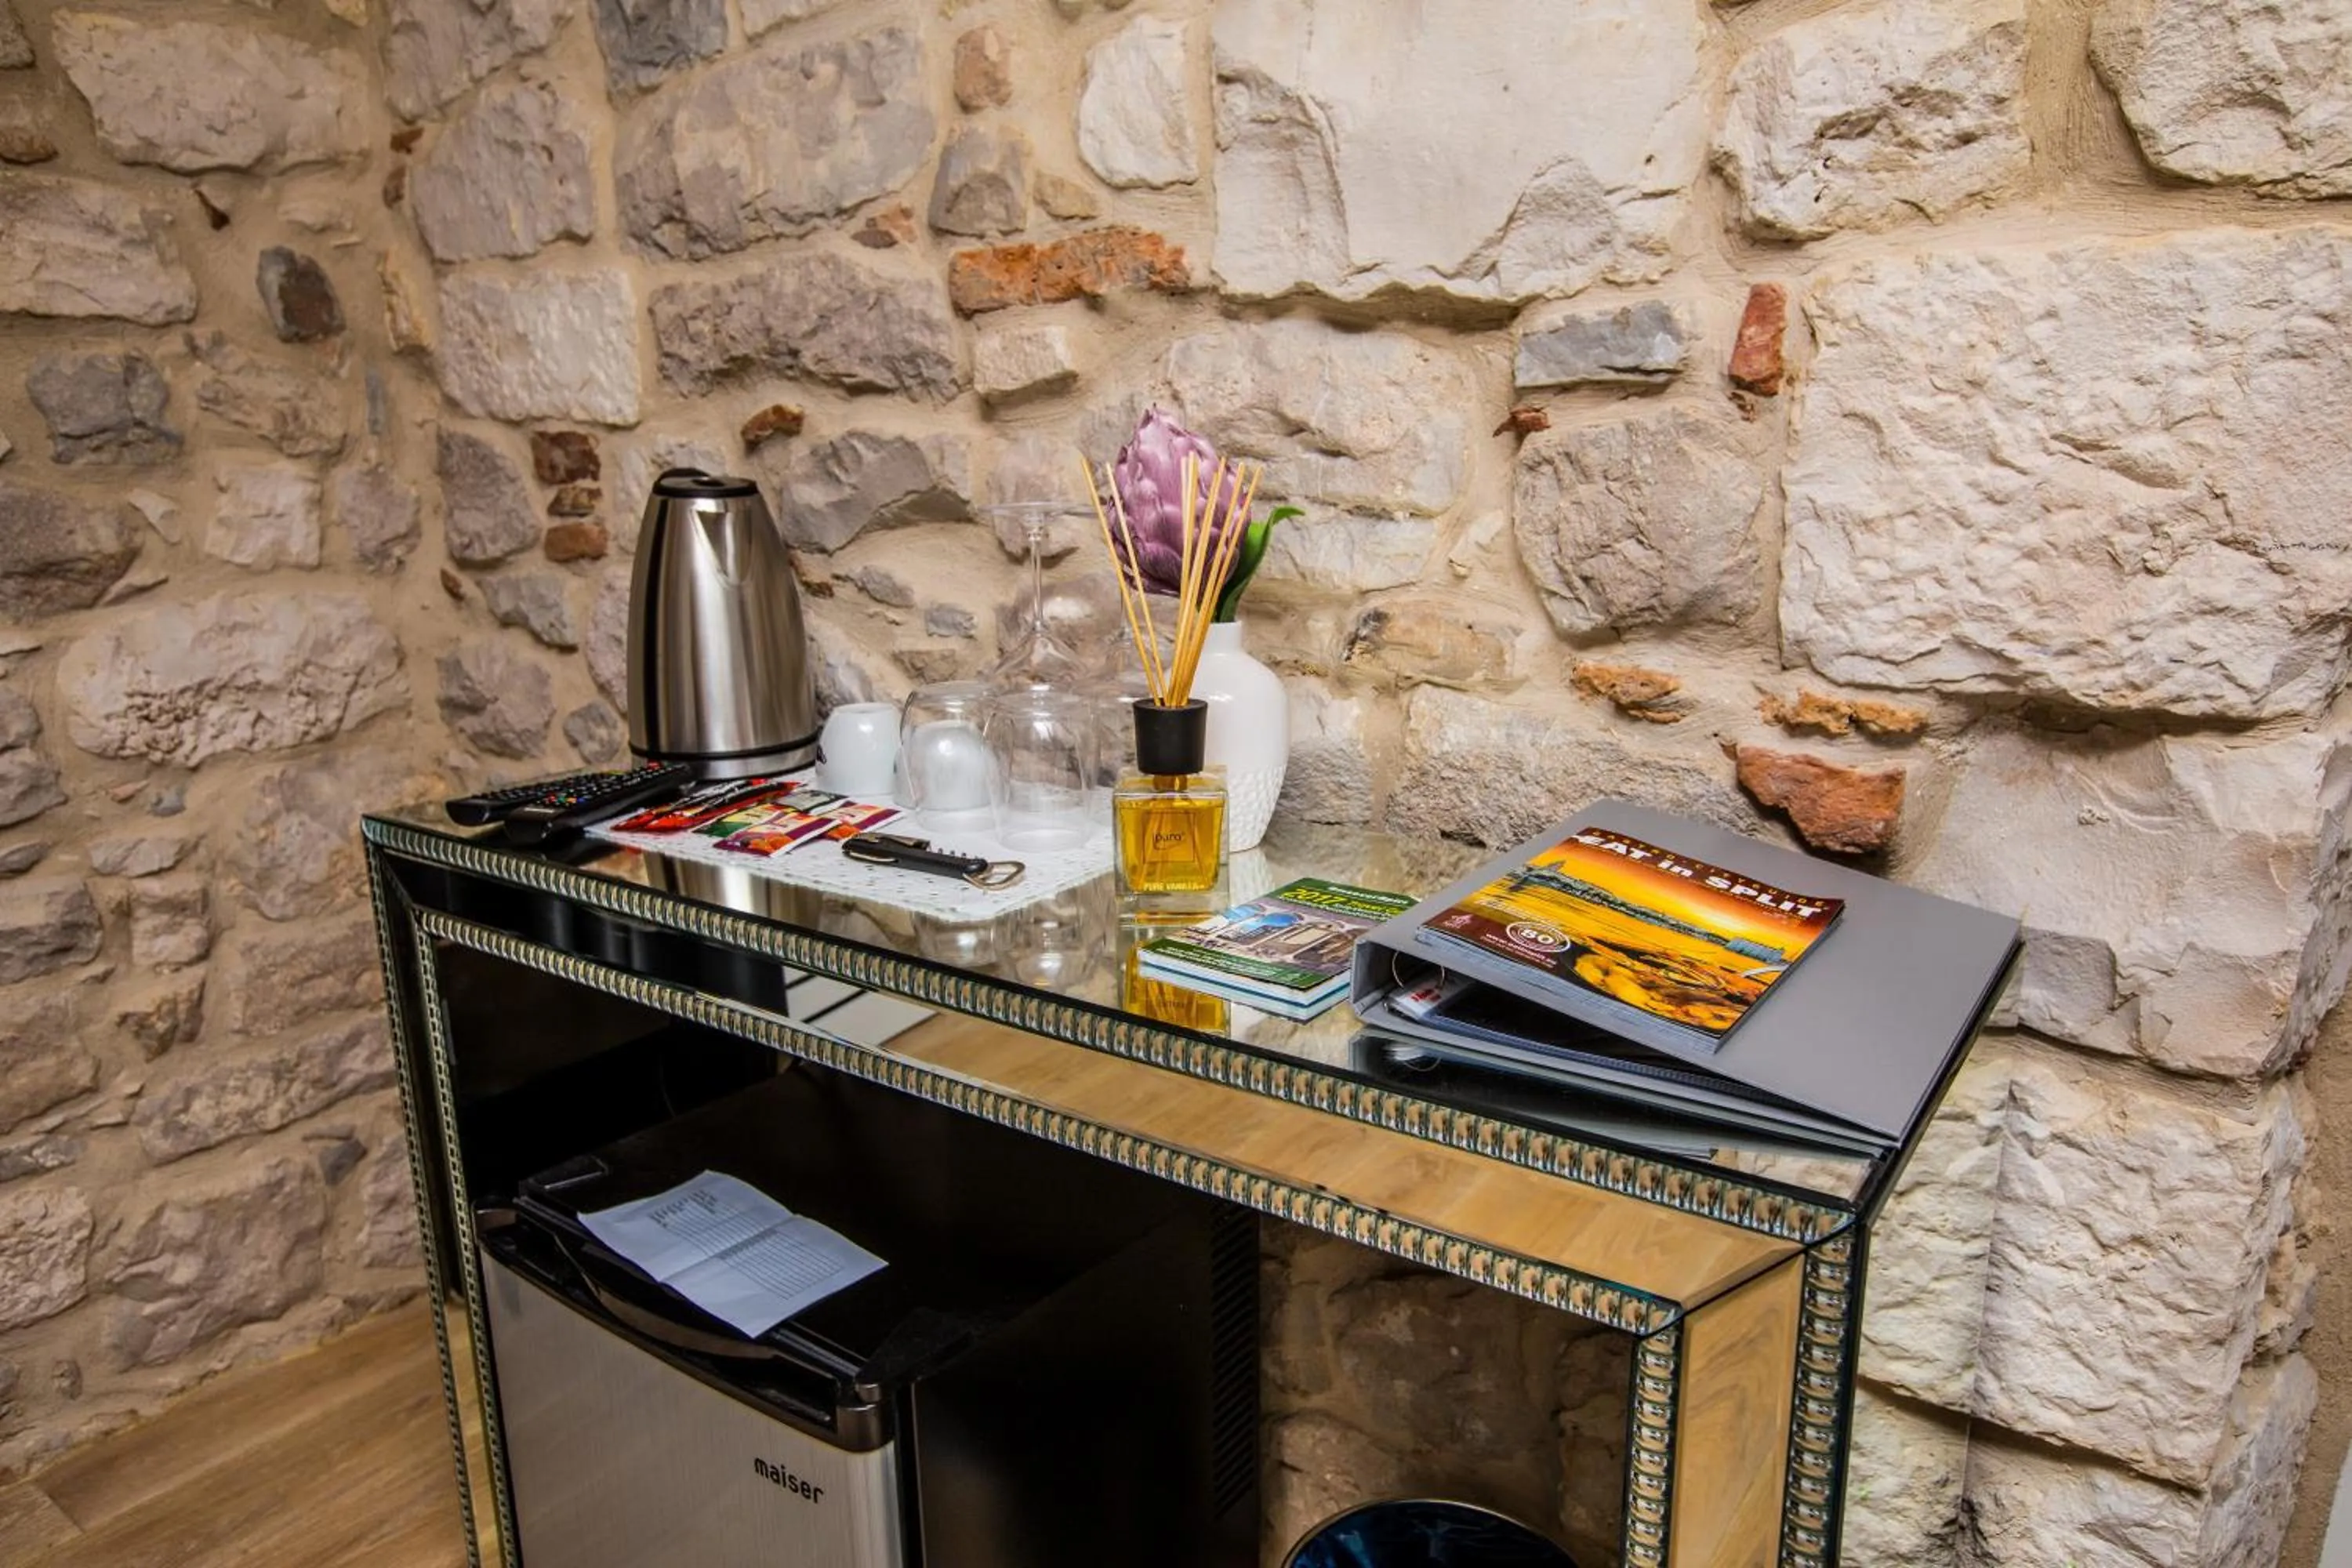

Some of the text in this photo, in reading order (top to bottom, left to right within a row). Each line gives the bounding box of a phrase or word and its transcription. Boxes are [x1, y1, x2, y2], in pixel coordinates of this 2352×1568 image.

[1279, 887, 1348, 904] 2017
[1573, 835, 1653, 859] EAT
[1657, 859, 1693, 877] in
[1705, 875, 1821, 918] SPLIT
[753, 1457, 825, 1504] maiser
